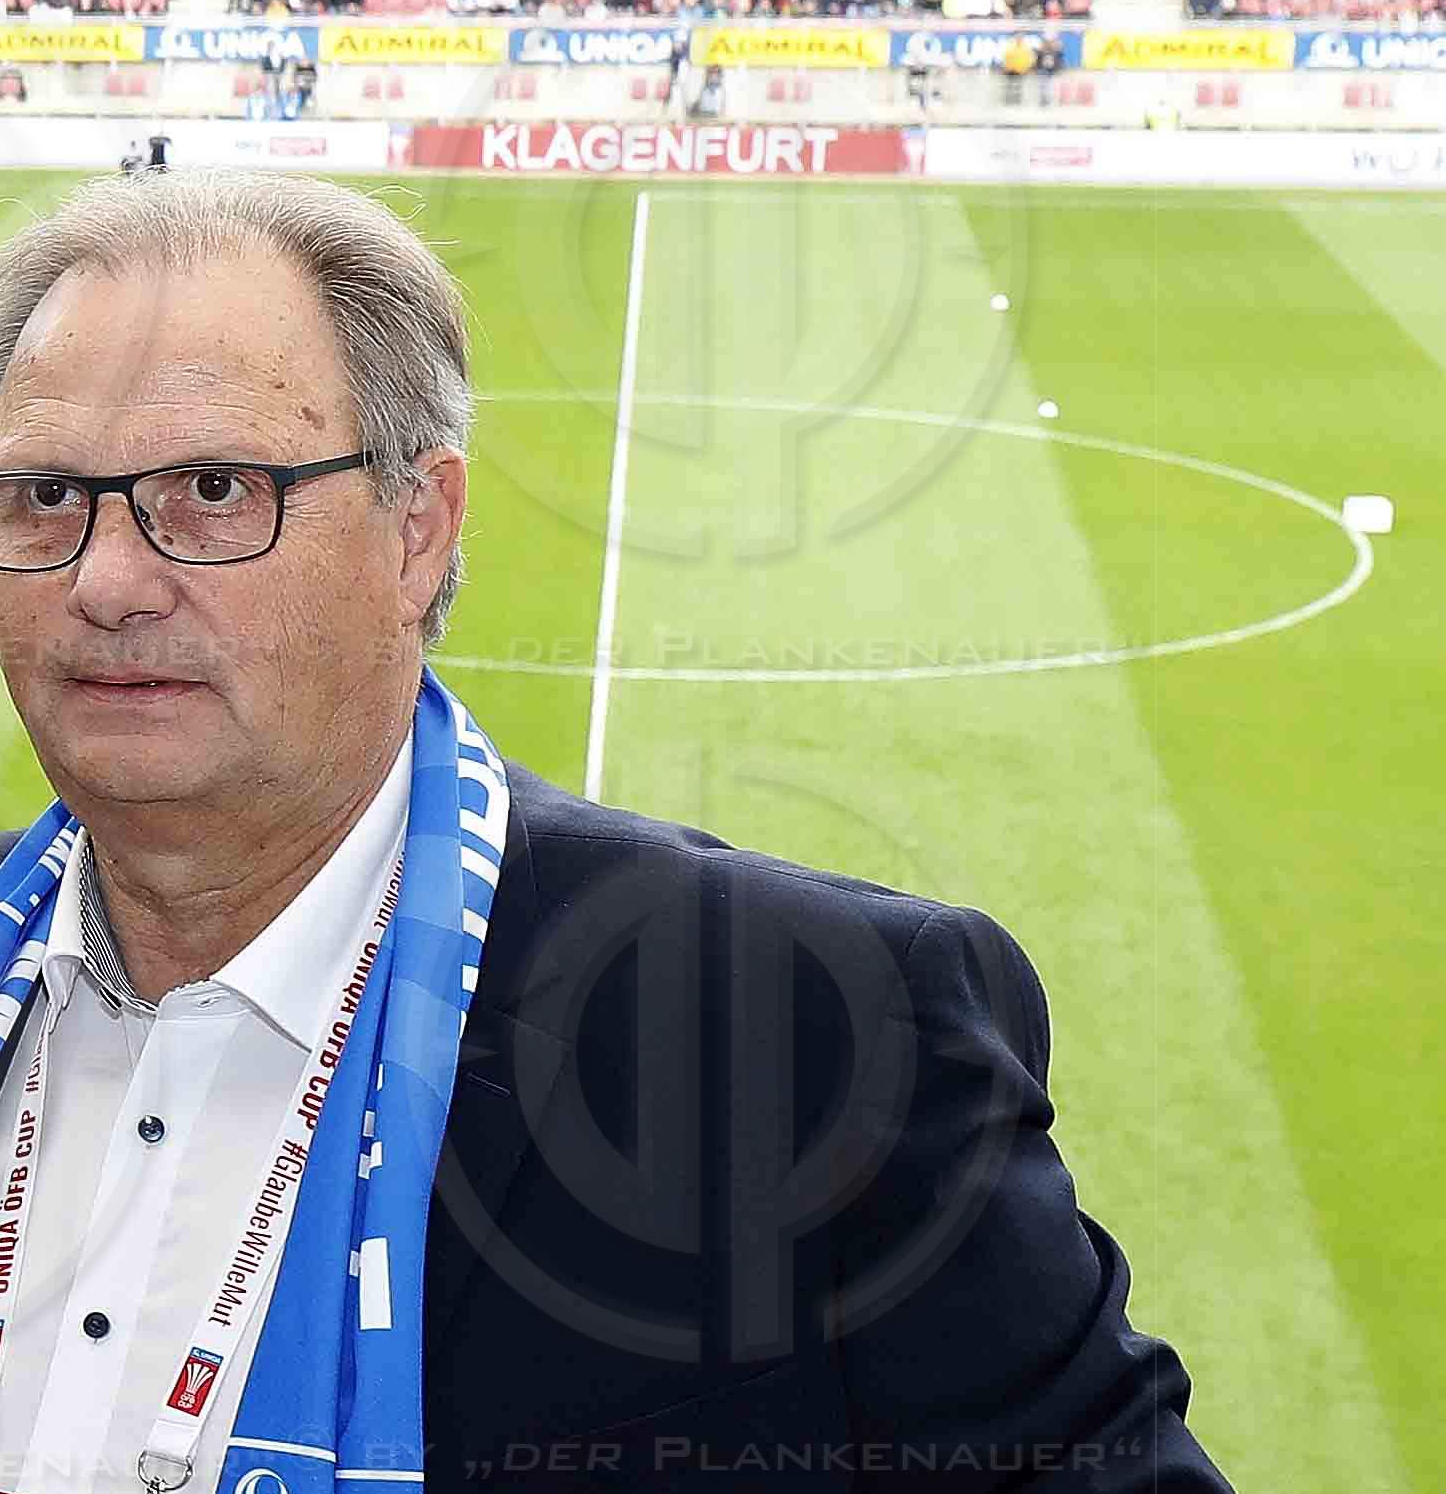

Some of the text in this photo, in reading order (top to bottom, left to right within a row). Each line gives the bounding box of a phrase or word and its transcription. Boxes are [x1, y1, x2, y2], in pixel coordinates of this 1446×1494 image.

[203, 28, 306, 60] UNIQA
[334, 33, 488, 55] ADMIRAL
[709, 35, 866, 59] ADMIRAL
[482, 123, 839, 173] KLAGENFURT
[14, 1108, 37, 1159] CUP
[206, 1137, 312, 1329] #GlaubeWilleMut
